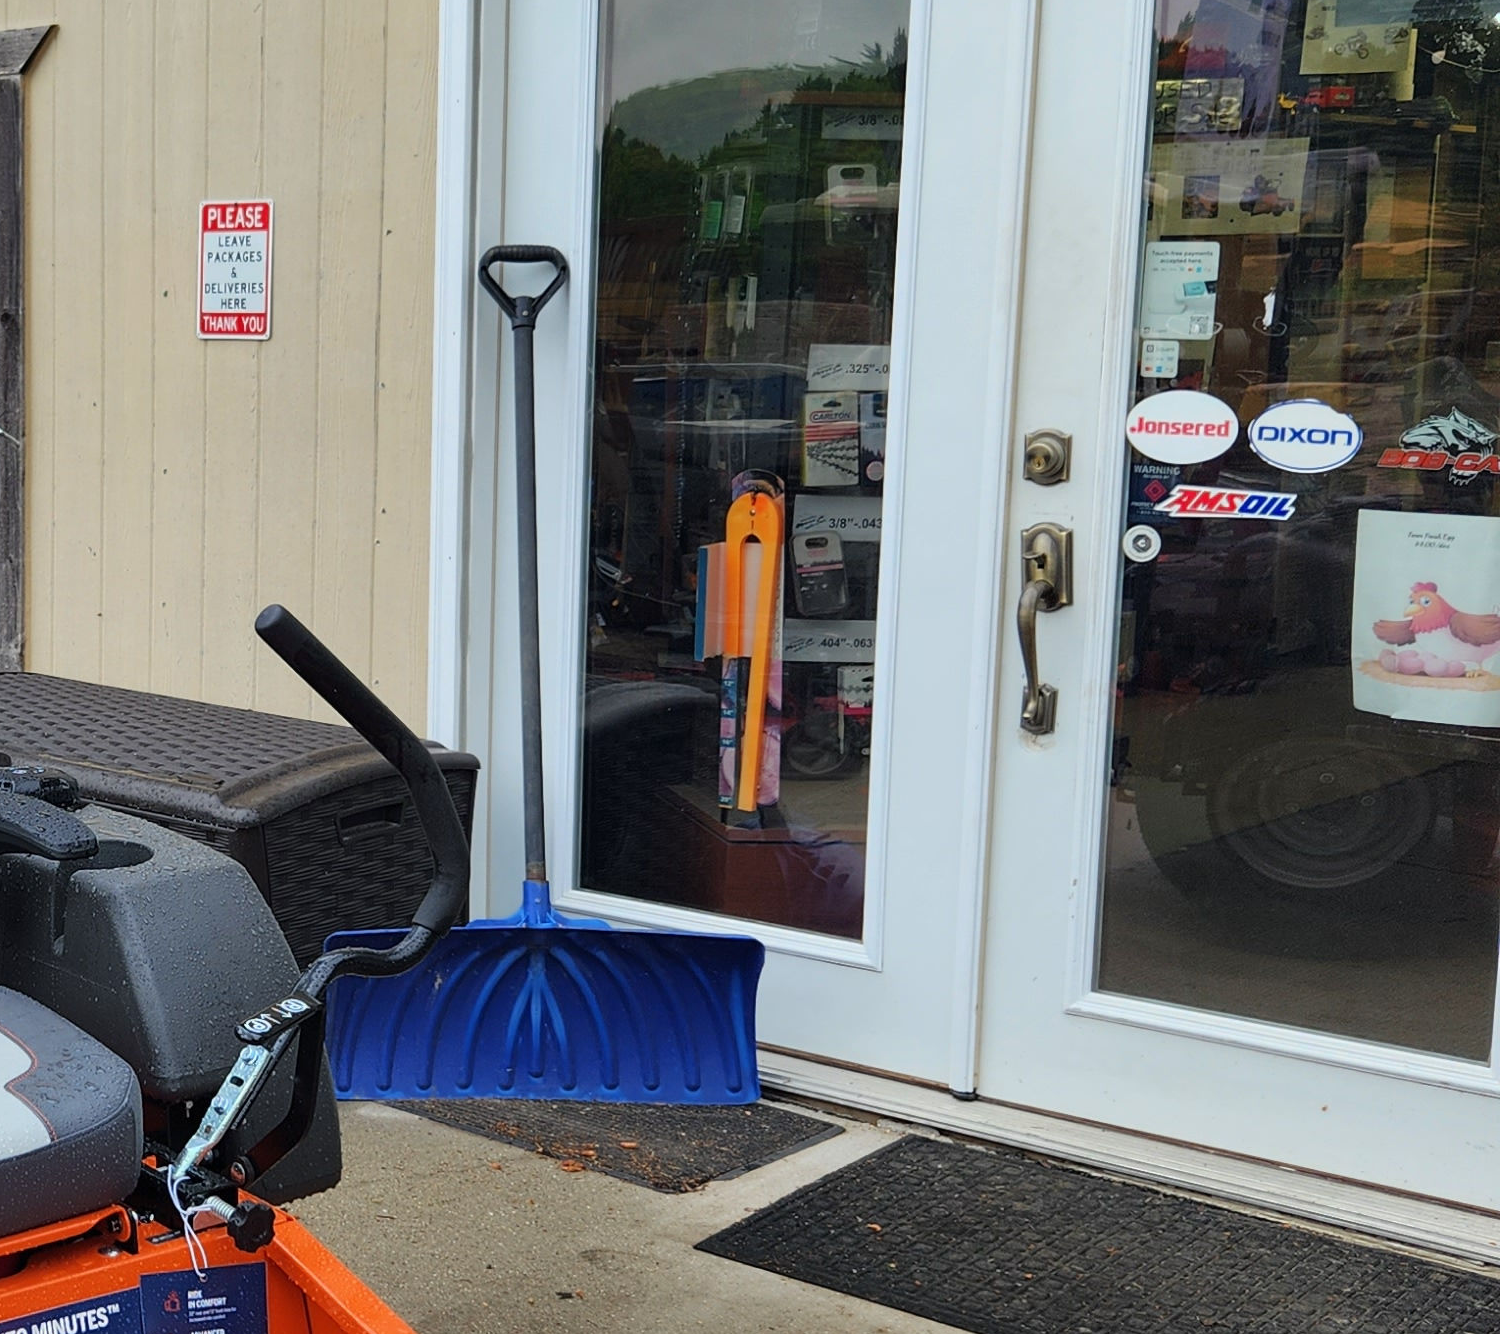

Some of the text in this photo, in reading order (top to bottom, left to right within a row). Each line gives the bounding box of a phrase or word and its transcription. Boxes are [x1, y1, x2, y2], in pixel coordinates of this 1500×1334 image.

[207, 206, 264, 230] PLEASE
[218, 235, 252, 248] LEAVE
[207, 250, 263, 263] PACKAGES
[230, 266, 238, 279] &
[204, 282, 265, 295] DELIVERIES
[220, 297, 247, 310] HERE
[202, 315, 266, 333] THANK YOU
[812, 411, 851, 421] CARLTON
[1129, 415, 1231, 439] Jonsered
[1257, 425, 1353, 447] DIXON
[1378, 449, 1500, 474] BOB-CA
[1133, 464, 1181, 476] WARNING
[1164, 487, 1297, 519] AMSOIL
[187, 1289, 203, 1300] RIDE
[187, 1296, 227, 1310] IN COMFORT
